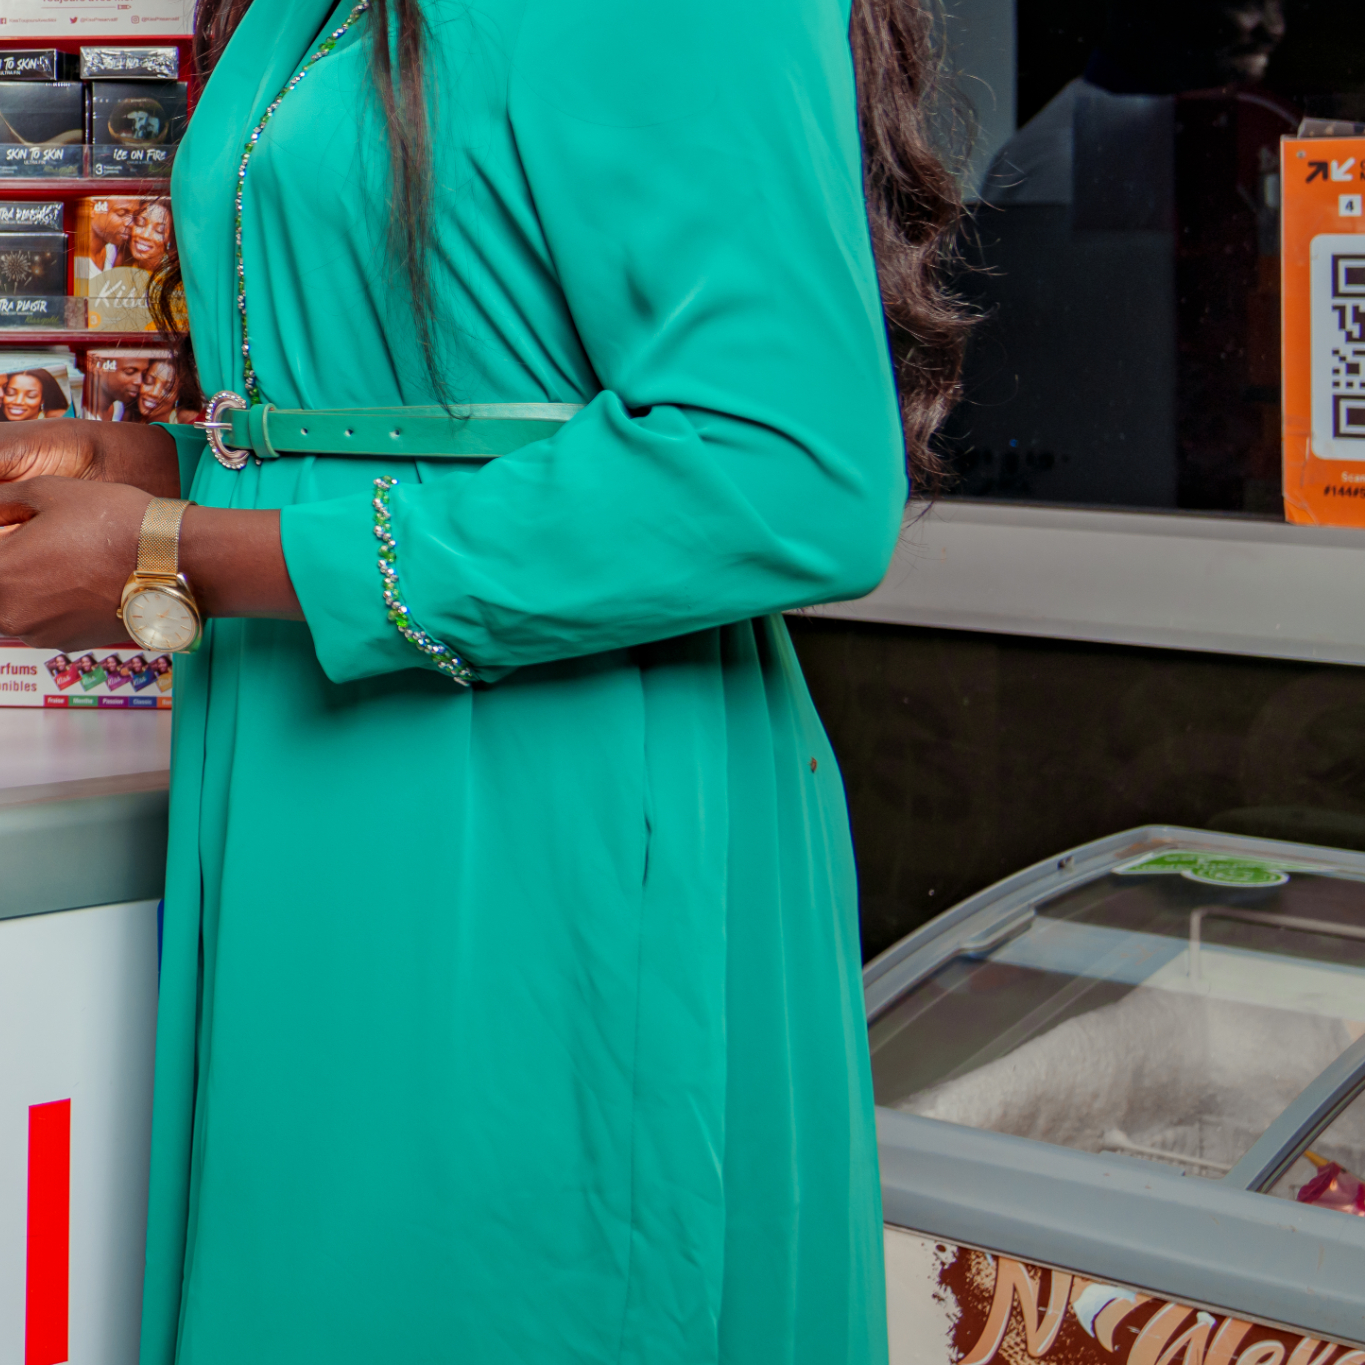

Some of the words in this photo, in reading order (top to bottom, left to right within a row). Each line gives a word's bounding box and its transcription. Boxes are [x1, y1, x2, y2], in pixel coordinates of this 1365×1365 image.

[3, 57, 15, 70] TO
[17, 58, 37, 71] SKIN
[6, 148, 28, 160] SKIN
[29, 146, 41, 160] TO
[43, 148, 64, 160] SKIN
[131, 149, 144, 160] ON
[95, 163, 103, 175] 3
